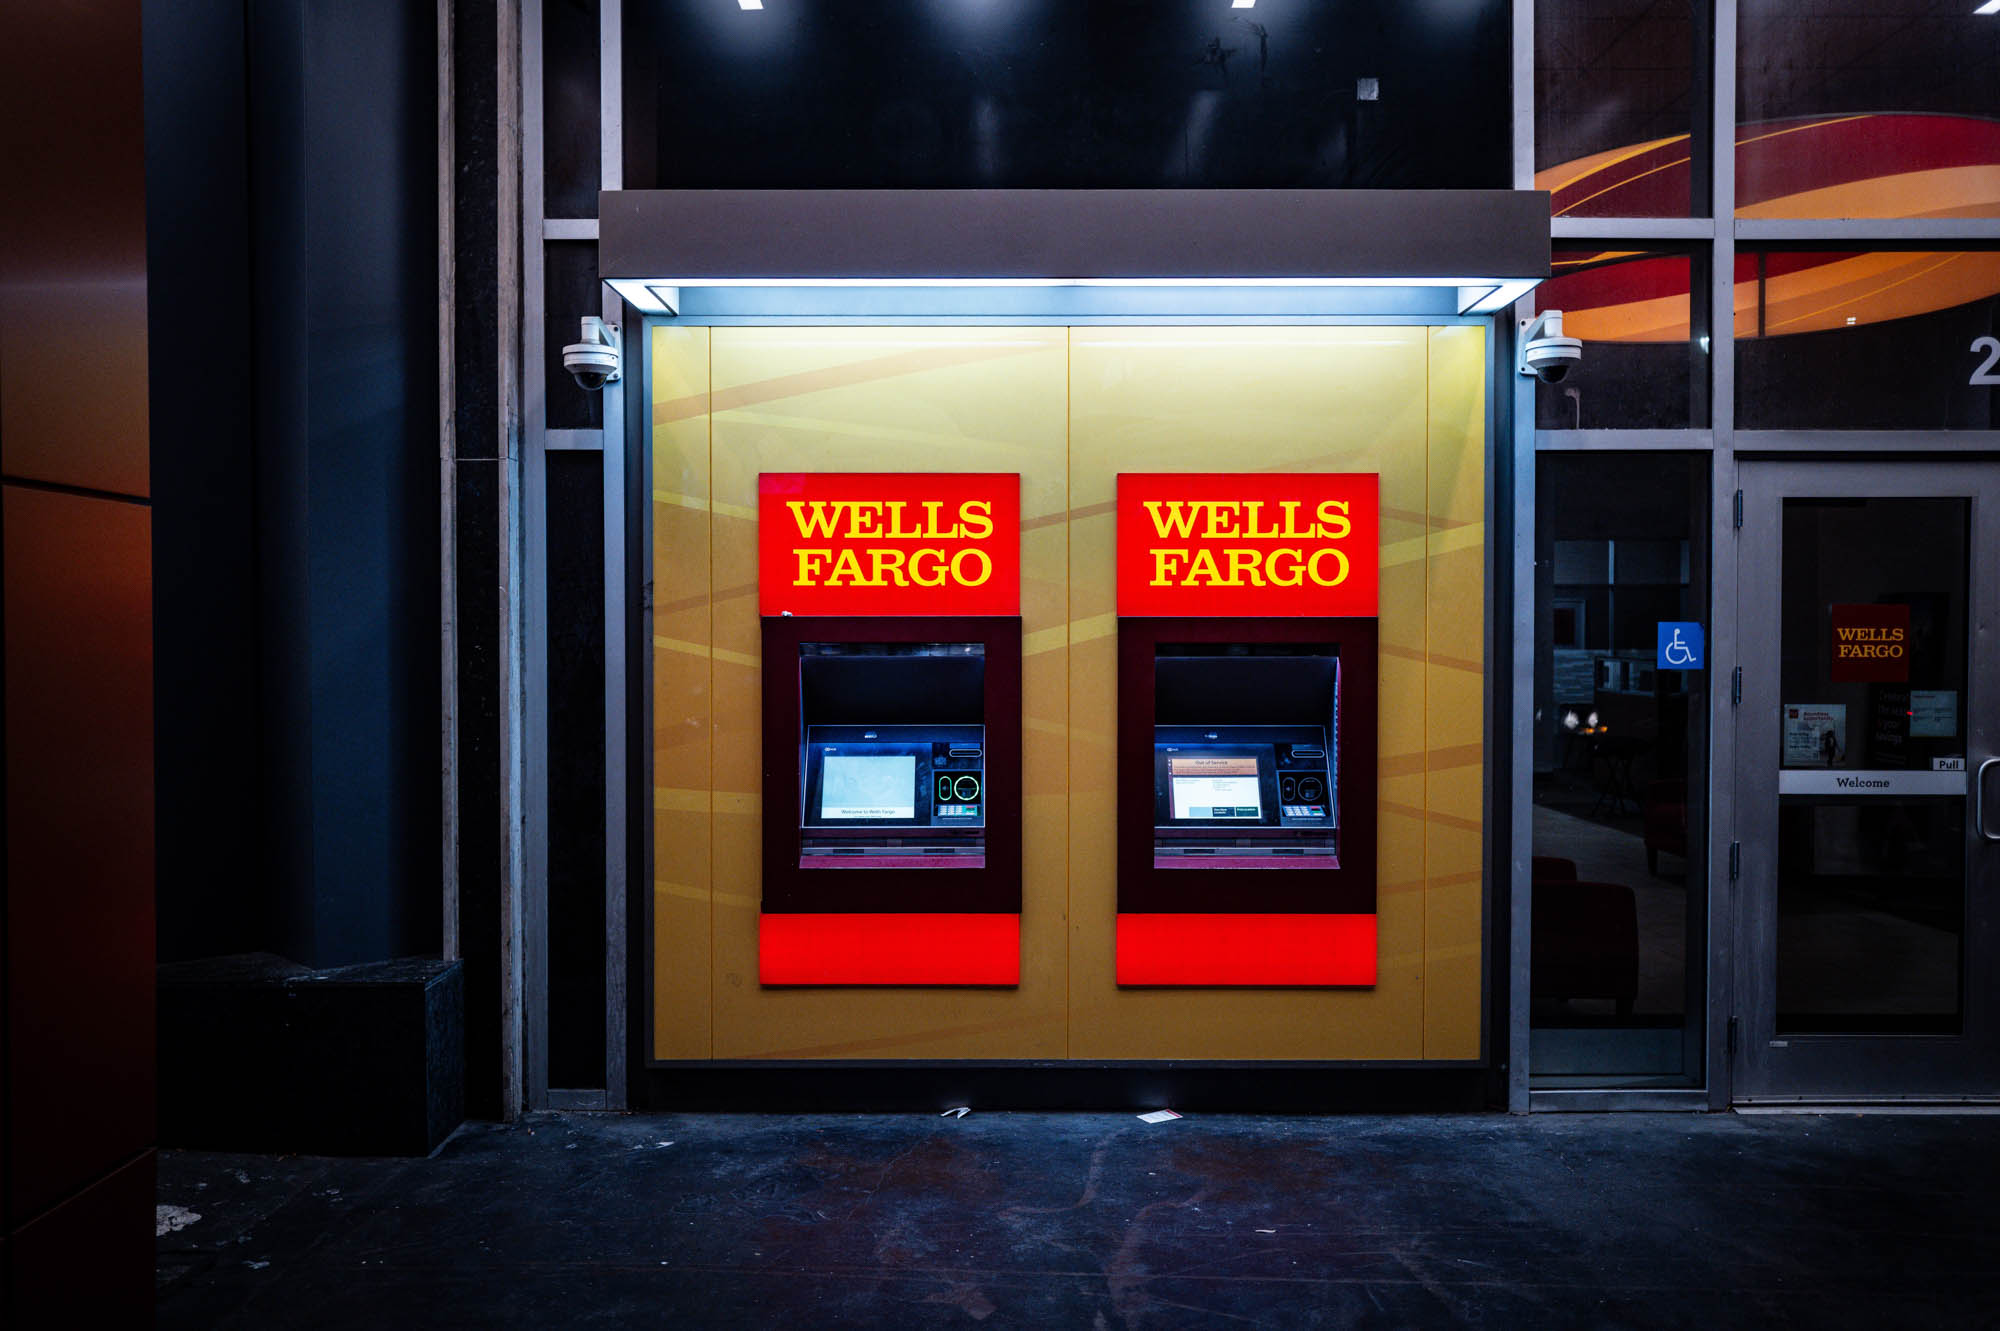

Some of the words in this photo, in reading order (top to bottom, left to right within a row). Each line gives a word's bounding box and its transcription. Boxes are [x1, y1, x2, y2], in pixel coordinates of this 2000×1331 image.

[1968, 336, 2000, 385] 2
[786, 500, 994, 539] WELLS
[1143, 500, 1352, 539] WELLS
[793, 549, 993, 587] FARGO
[1149, 549, 1350, 587] FARGO
[1837, 628, 1904, 641] WELLS
[1838, 645, 1903, 658] FARGO
[1836, 777, 1890, 788] Welcome
[1939, 760, 1959, 769] Pull
